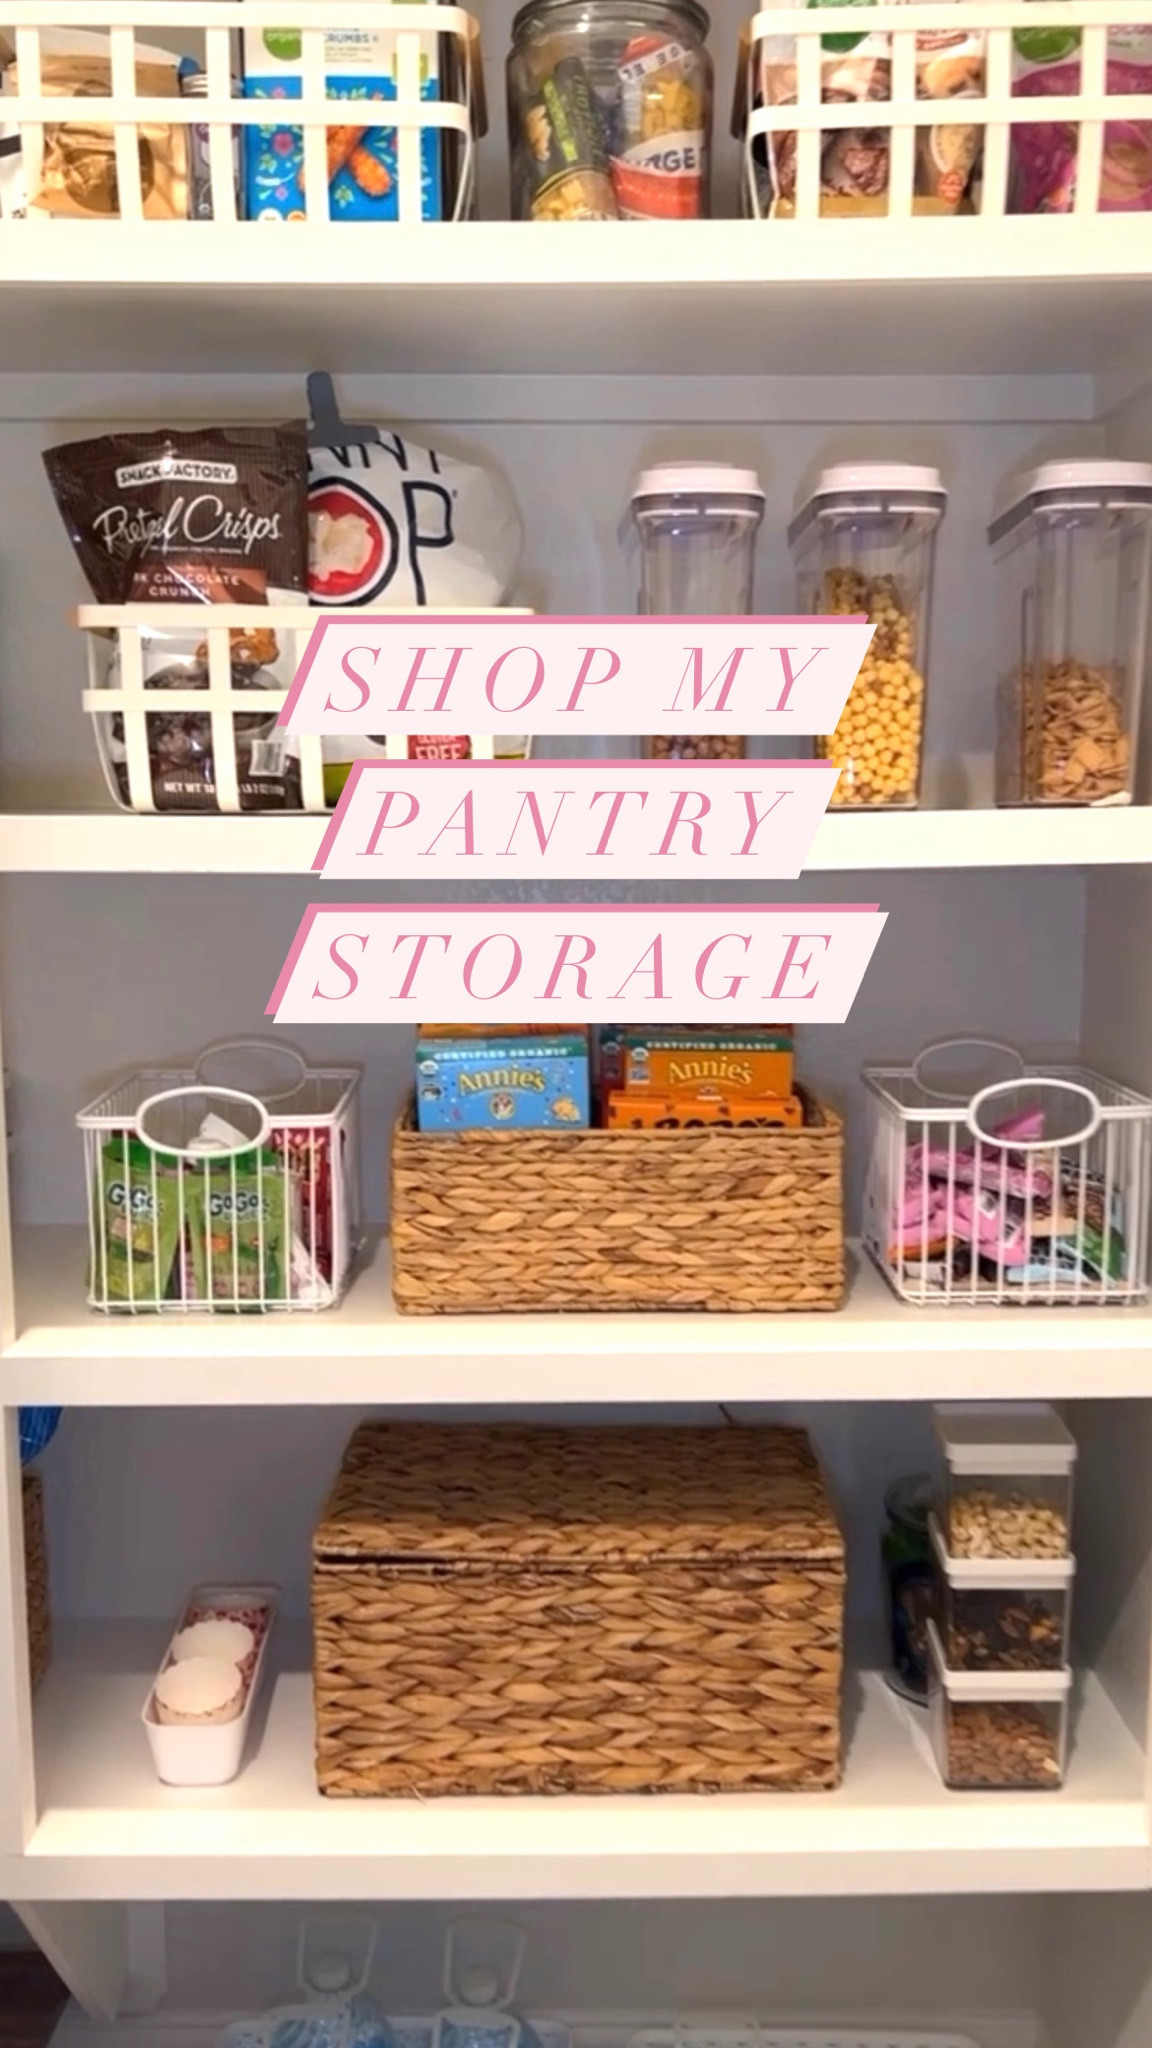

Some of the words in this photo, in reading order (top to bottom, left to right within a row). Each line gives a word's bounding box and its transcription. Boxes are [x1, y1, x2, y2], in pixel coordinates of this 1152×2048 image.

[120, 465, 161, 483] SNACK
[92, 496, 184, 558] Pretzel
[182, 494, 281, 555] Crisps
[415, 744, 462, 759] FREE
[646, 1040, 716, 1050] CERTIFIED
[719, 1041, 777, 1050] ORGANIC
[434, 1051, 506, 1061] CERTIFIED
[509, 1048, 568, 1058] ORGANIC
[669, 1056, 754, 1085] Annie's
[458, 1067, 546, 1096] Annie's
